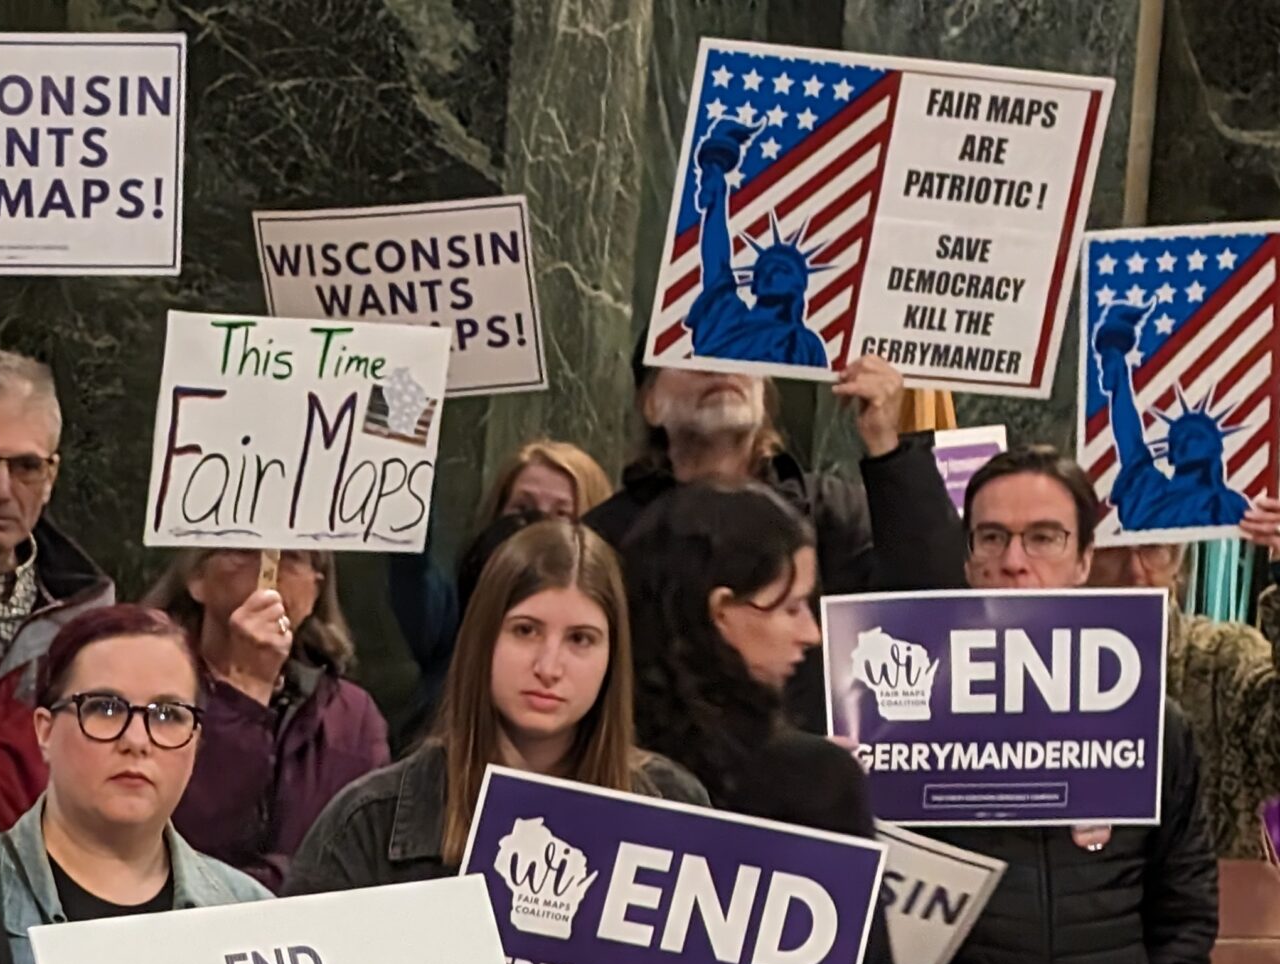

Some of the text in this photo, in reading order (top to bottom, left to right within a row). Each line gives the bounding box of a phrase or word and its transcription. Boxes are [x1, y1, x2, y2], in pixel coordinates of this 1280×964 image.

[926, 88, 1059, 128] FAIR MAPS
[958, 133, 1009, 164] ARE
[903, 168, 1033, 208] PATRIOTIC
[266, 230, 520, 277] WISCONSIN
[936, 234, 992, 263] SAVE
[315, 277, 473, 317] WANTS
[887, 266, 1026, 303] DEMOCRACY
[903, 304, 995, 336] KILL THE
[211, 320, 386, 379] This Time
[861, 336, 1022, 375] GERRYMANDER
[154, 386, 433, 543] Fair Maps
[950, 628, 1142, 713] END
[858, 739, 1145, 772] GERRYMANDERING!
[515, 905, 570, 922] COALITION
[517, 894, 571, 911] FAIR MAPS
